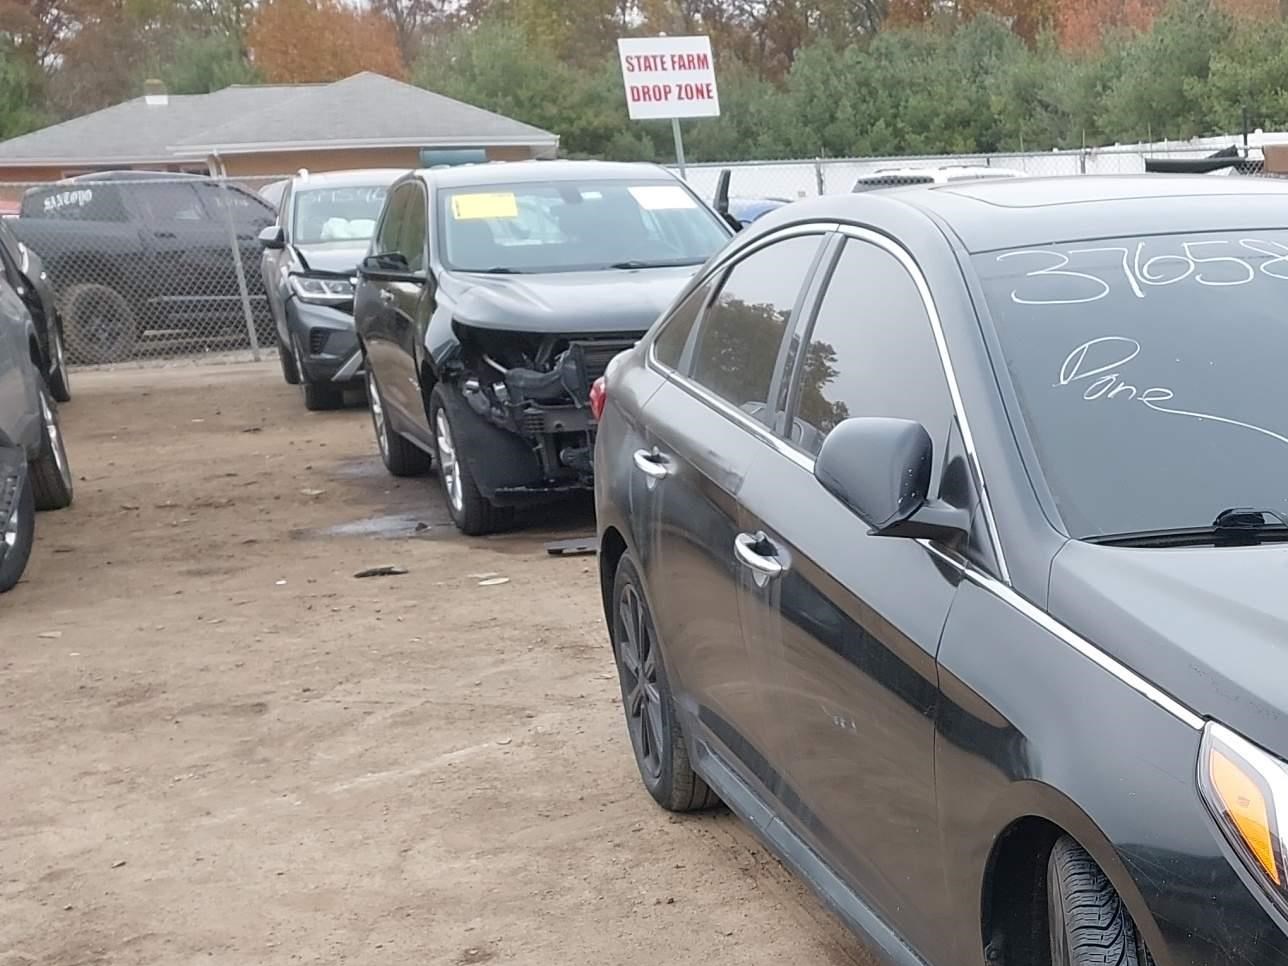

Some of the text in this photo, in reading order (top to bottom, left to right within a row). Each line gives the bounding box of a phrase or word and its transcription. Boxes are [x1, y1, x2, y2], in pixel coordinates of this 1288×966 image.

[625, 53, 710, 72] STATE FARM
[631, 83, 713, 102] DROP ZONE
